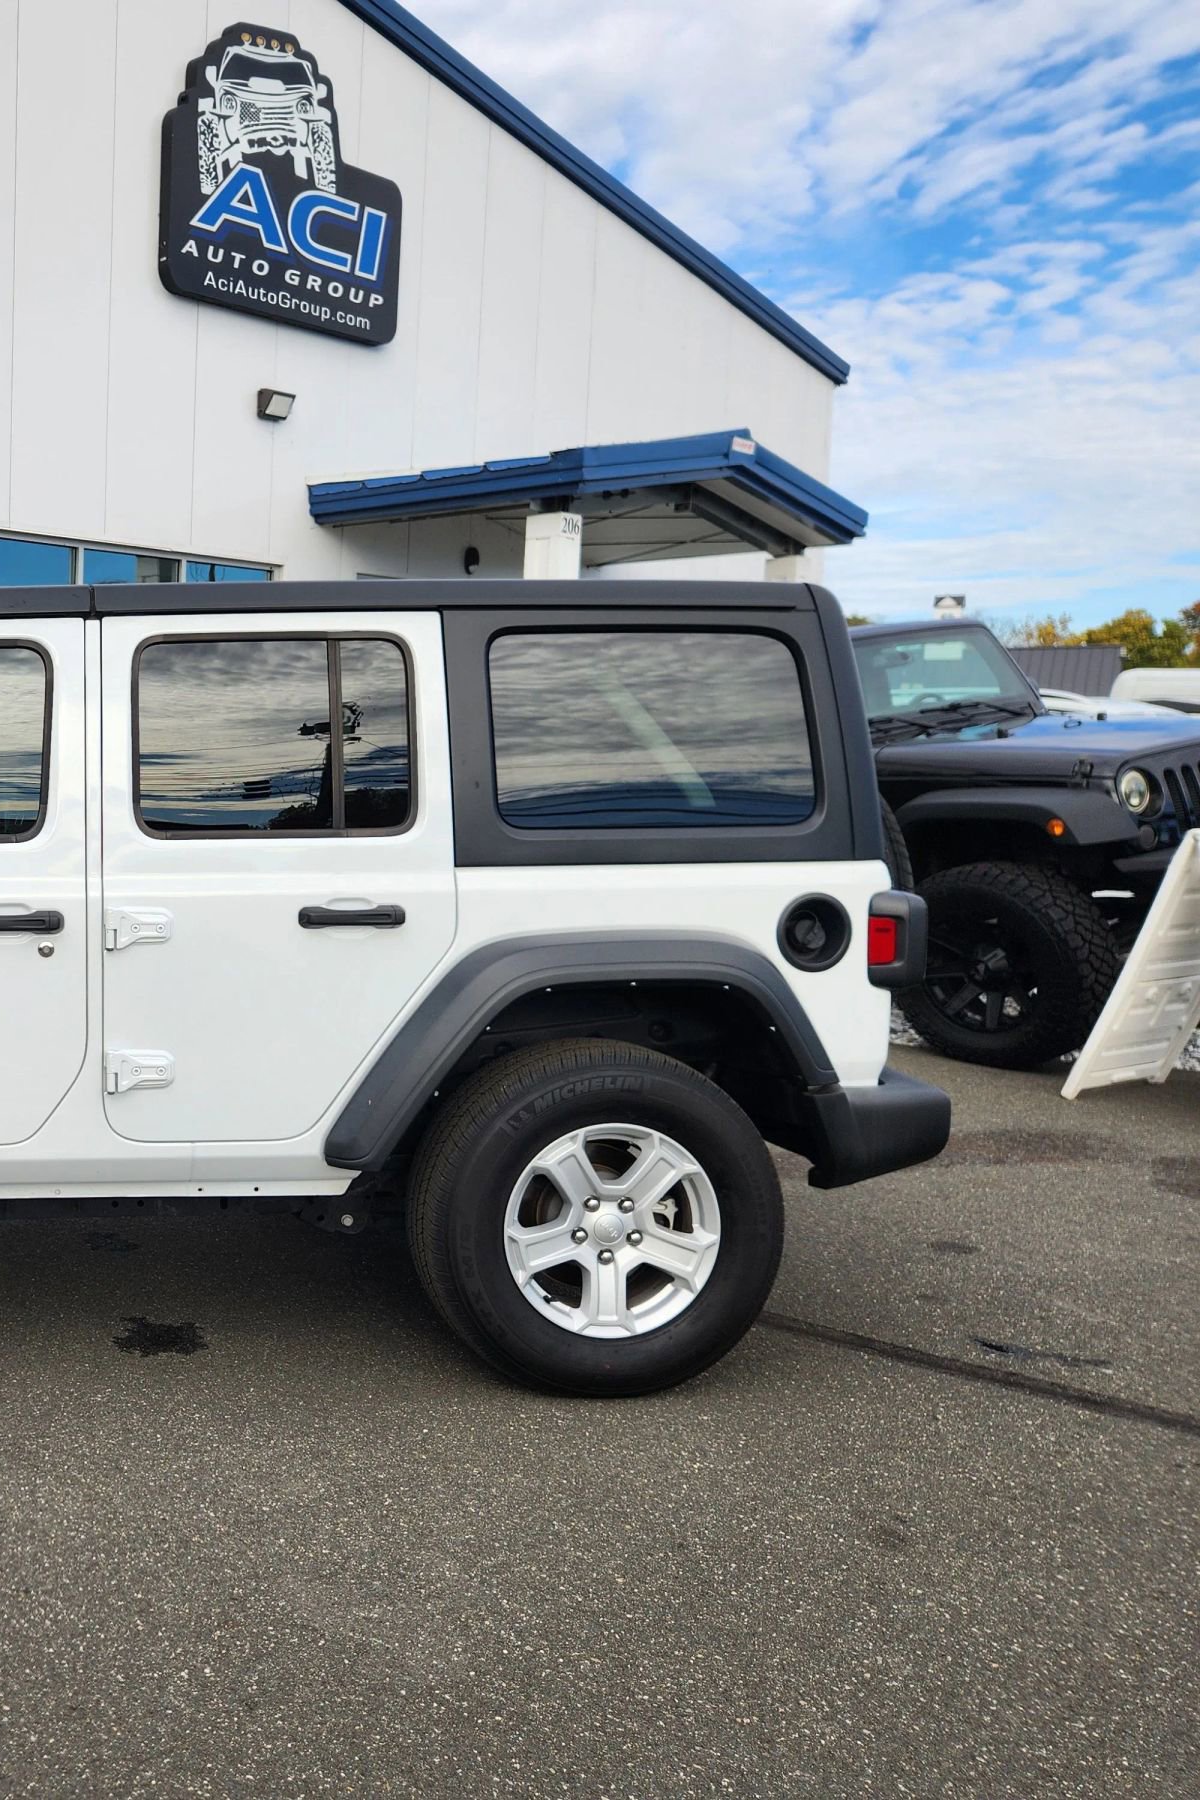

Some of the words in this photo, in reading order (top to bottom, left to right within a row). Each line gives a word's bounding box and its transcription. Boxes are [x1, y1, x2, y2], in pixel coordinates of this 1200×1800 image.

[189, 161, 388, 282] ACI
[181, 239, 270, 276] AUTO
[284, 269, 385, 308] GROUP
[203, 271, 371, 331] AciAutoGroup.com
[560, 516, 580, 535] 206
[534, 1075, 642, 1113] MICHELIN
